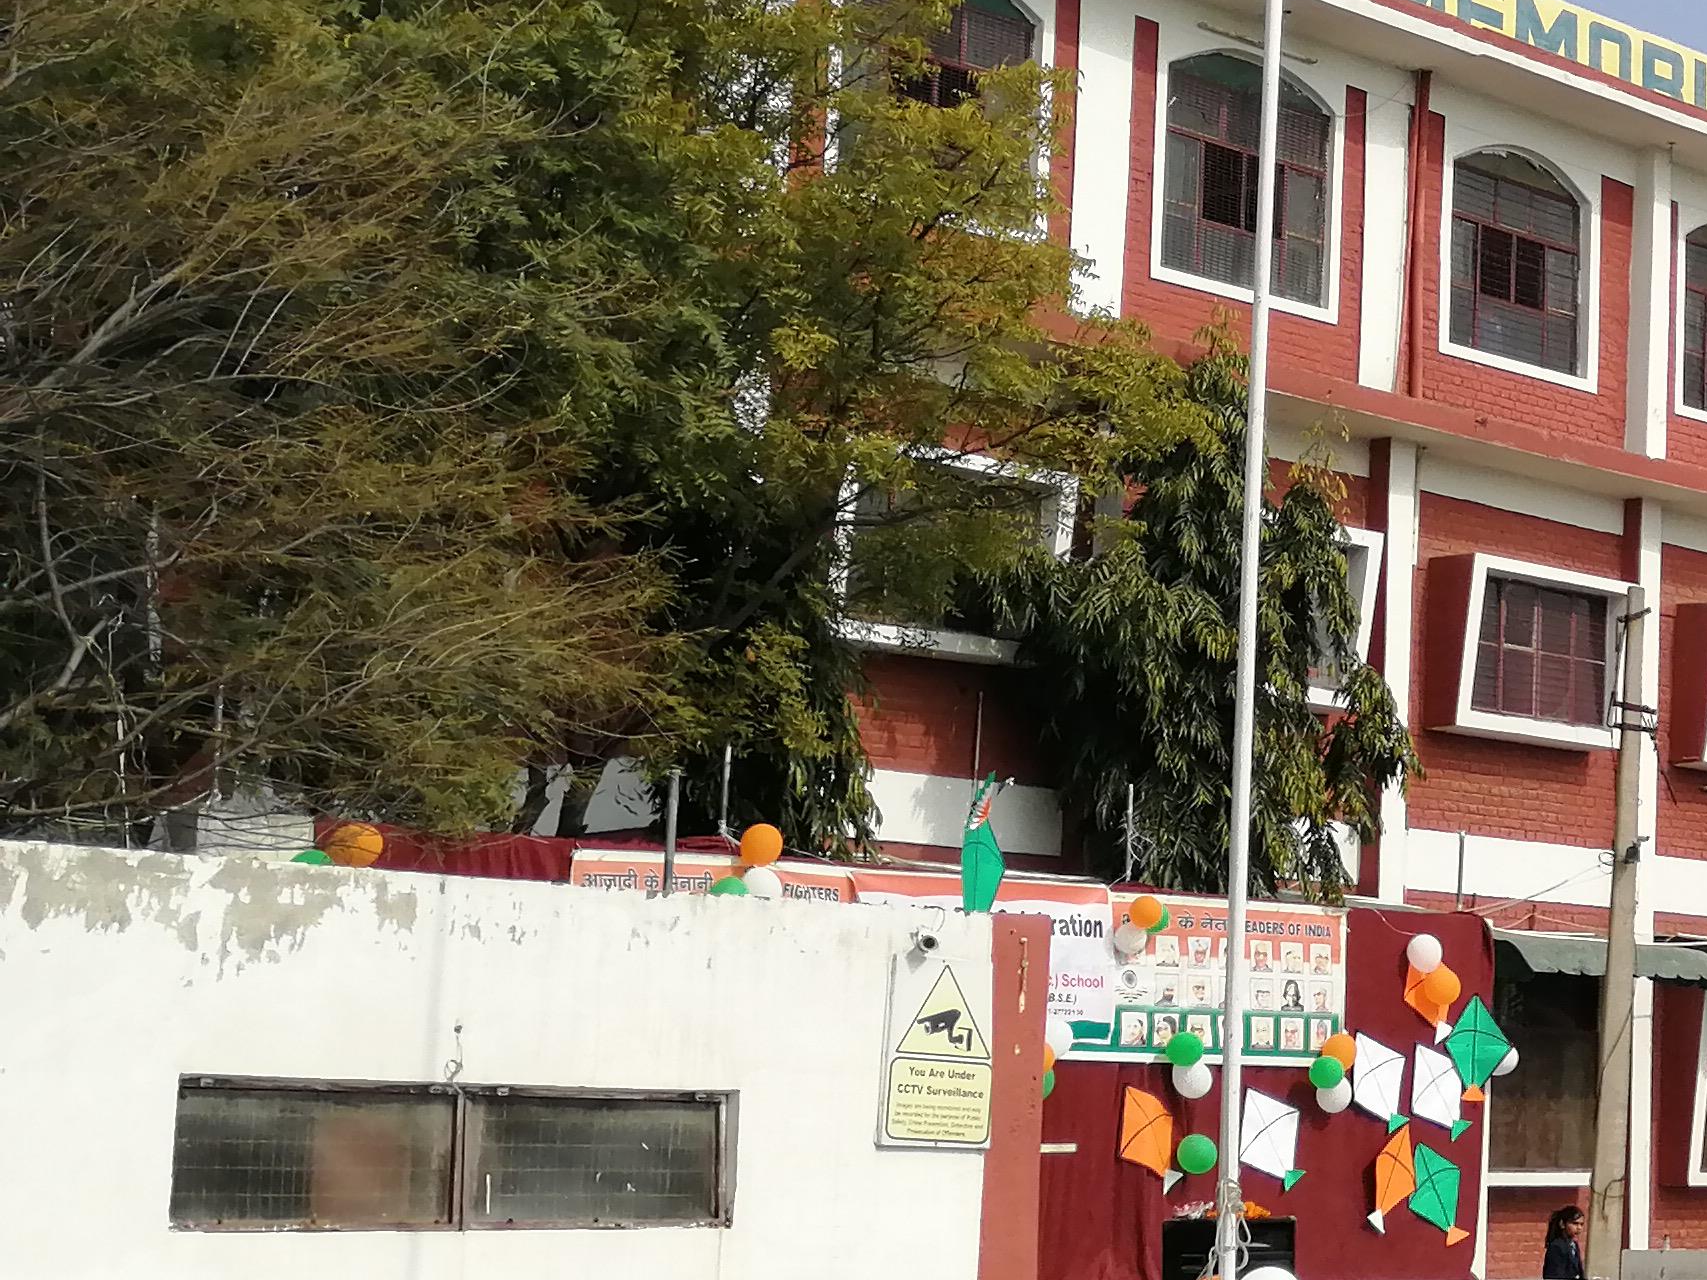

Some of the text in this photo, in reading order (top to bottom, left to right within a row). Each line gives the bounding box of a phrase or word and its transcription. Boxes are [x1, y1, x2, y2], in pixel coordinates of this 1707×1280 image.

[782, 883, 840, 902] FIGHTERS
[1051, 913, 1104, 938] ration
[1177, 911, 1229, 931] के नेत
[1245, 921, 1332, 937] EADERS OF INDIA
[1062, 973, 1104, 988] School
[909, 1066, 976, 1080] You Are Under
[897, 1083, 984, 1099] CCTV Surveillance
